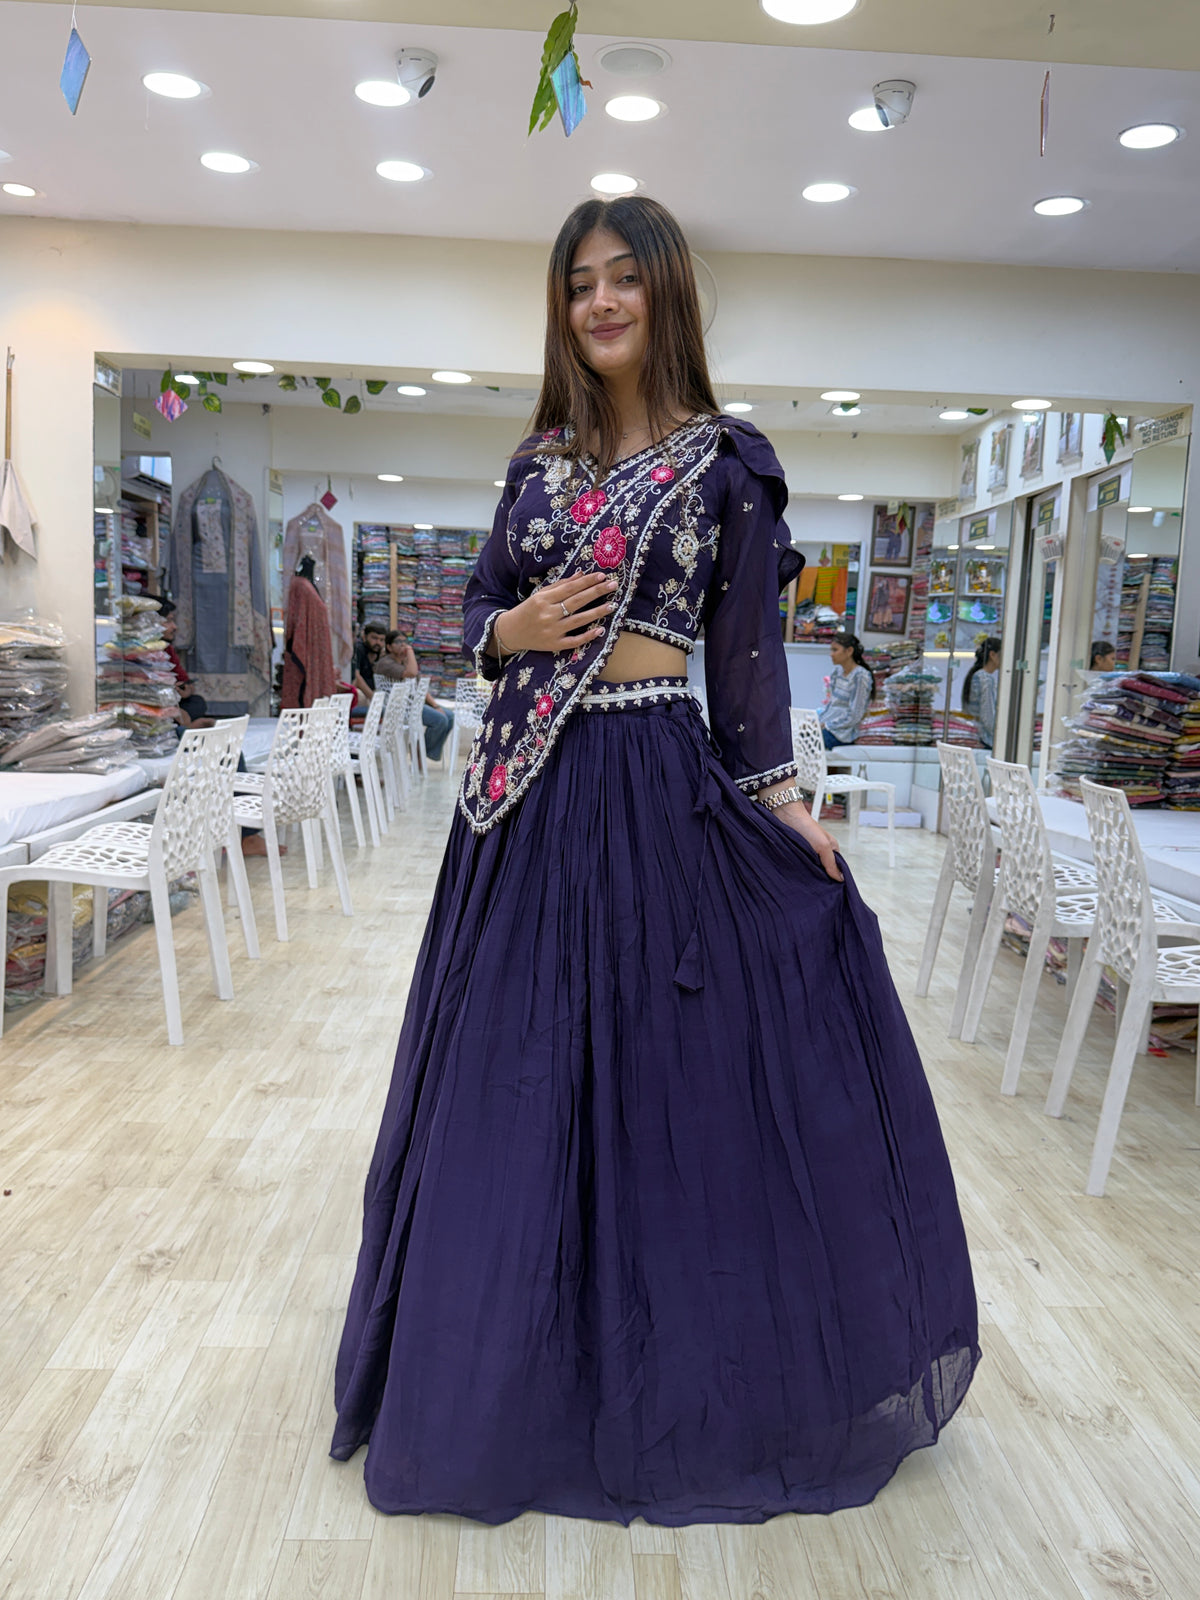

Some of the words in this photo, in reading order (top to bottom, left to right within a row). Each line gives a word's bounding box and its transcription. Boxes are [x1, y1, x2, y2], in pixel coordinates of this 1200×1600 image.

[1142, 430, 1151, 438] NO
[1152, 421, 1179, 434] REFUND
[1142, 437, 1151, 445] NO
